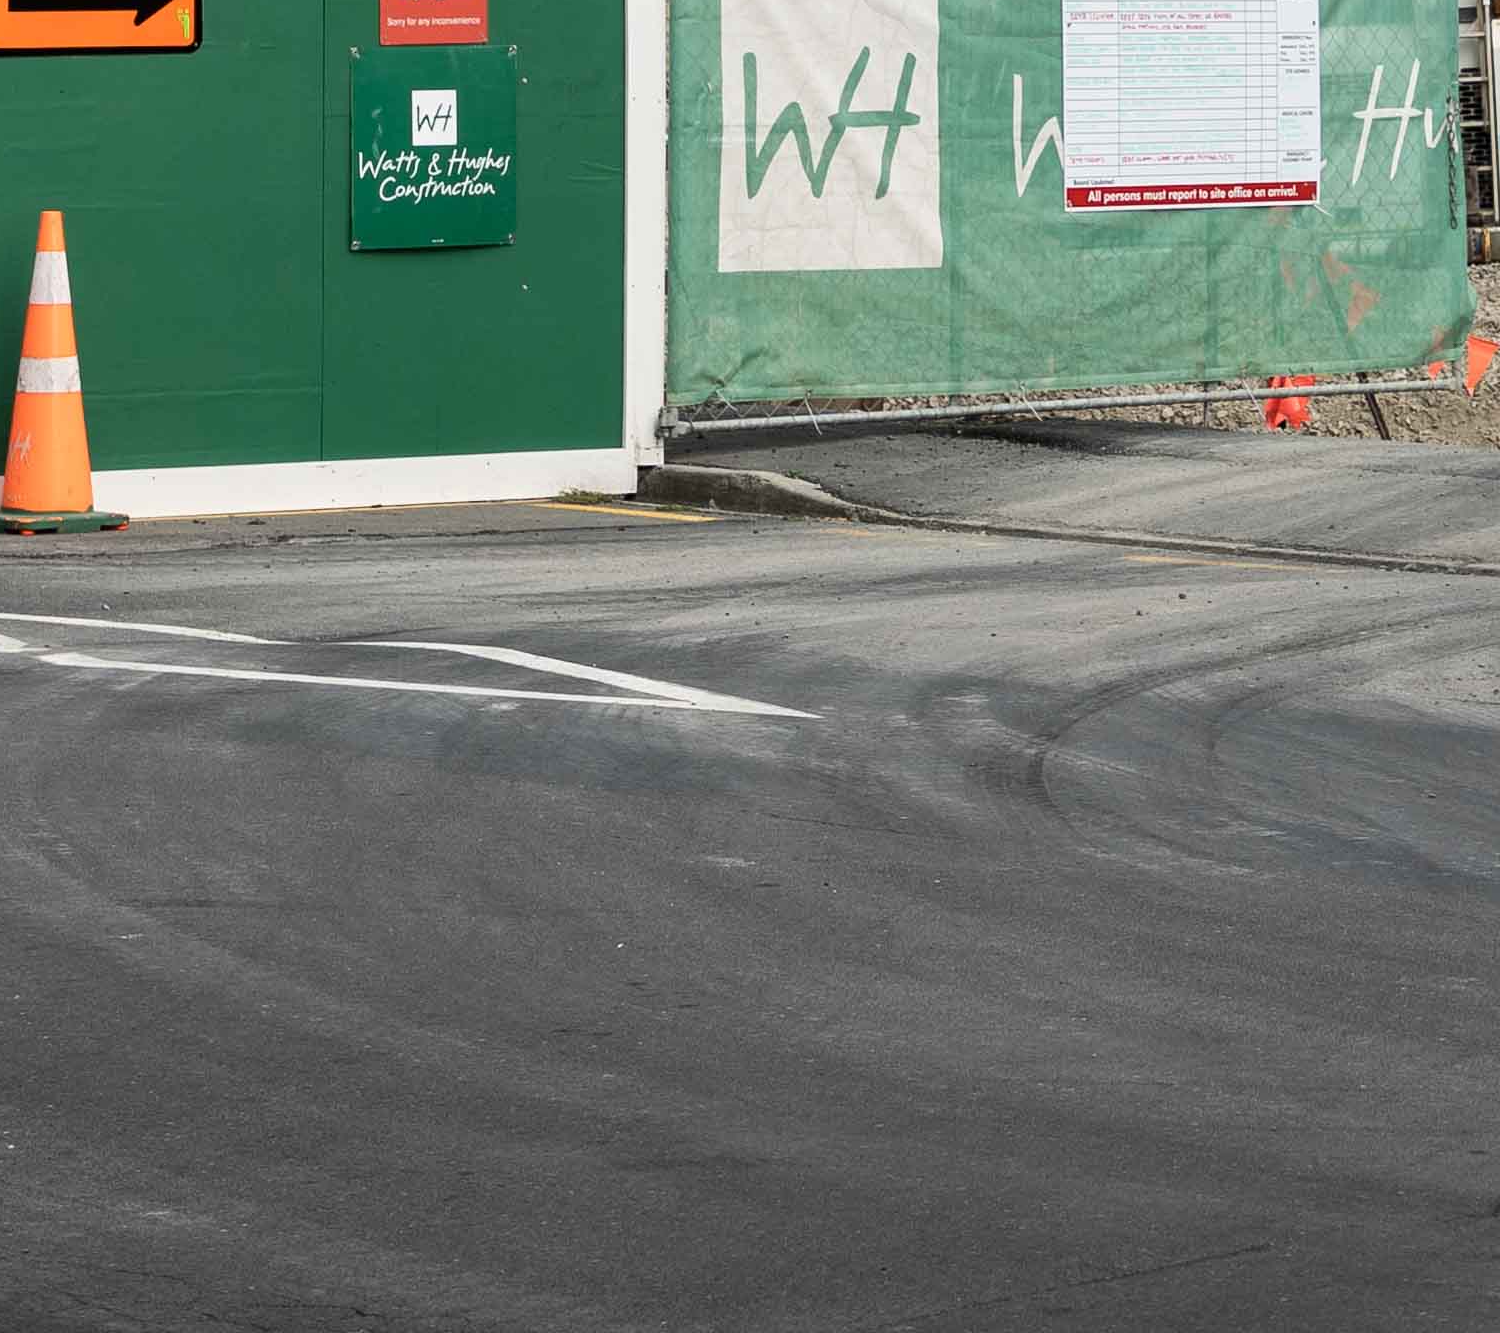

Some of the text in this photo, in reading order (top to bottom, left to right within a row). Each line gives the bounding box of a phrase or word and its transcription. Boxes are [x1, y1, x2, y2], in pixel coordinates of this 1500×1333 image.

[387, 17, 405, 28] Sorry
[406, 16, 417, 26] for
[418, 17, 430, 28] any
[417, 103, 452, 132] WH
[743, 46, 921, 200] WH
[358, 147, 511, 182] Watts & Hughes
[379, 175, 496, 204] Construction
[1087, 185, 1298, 204] All persons must report to site office on arrival.
